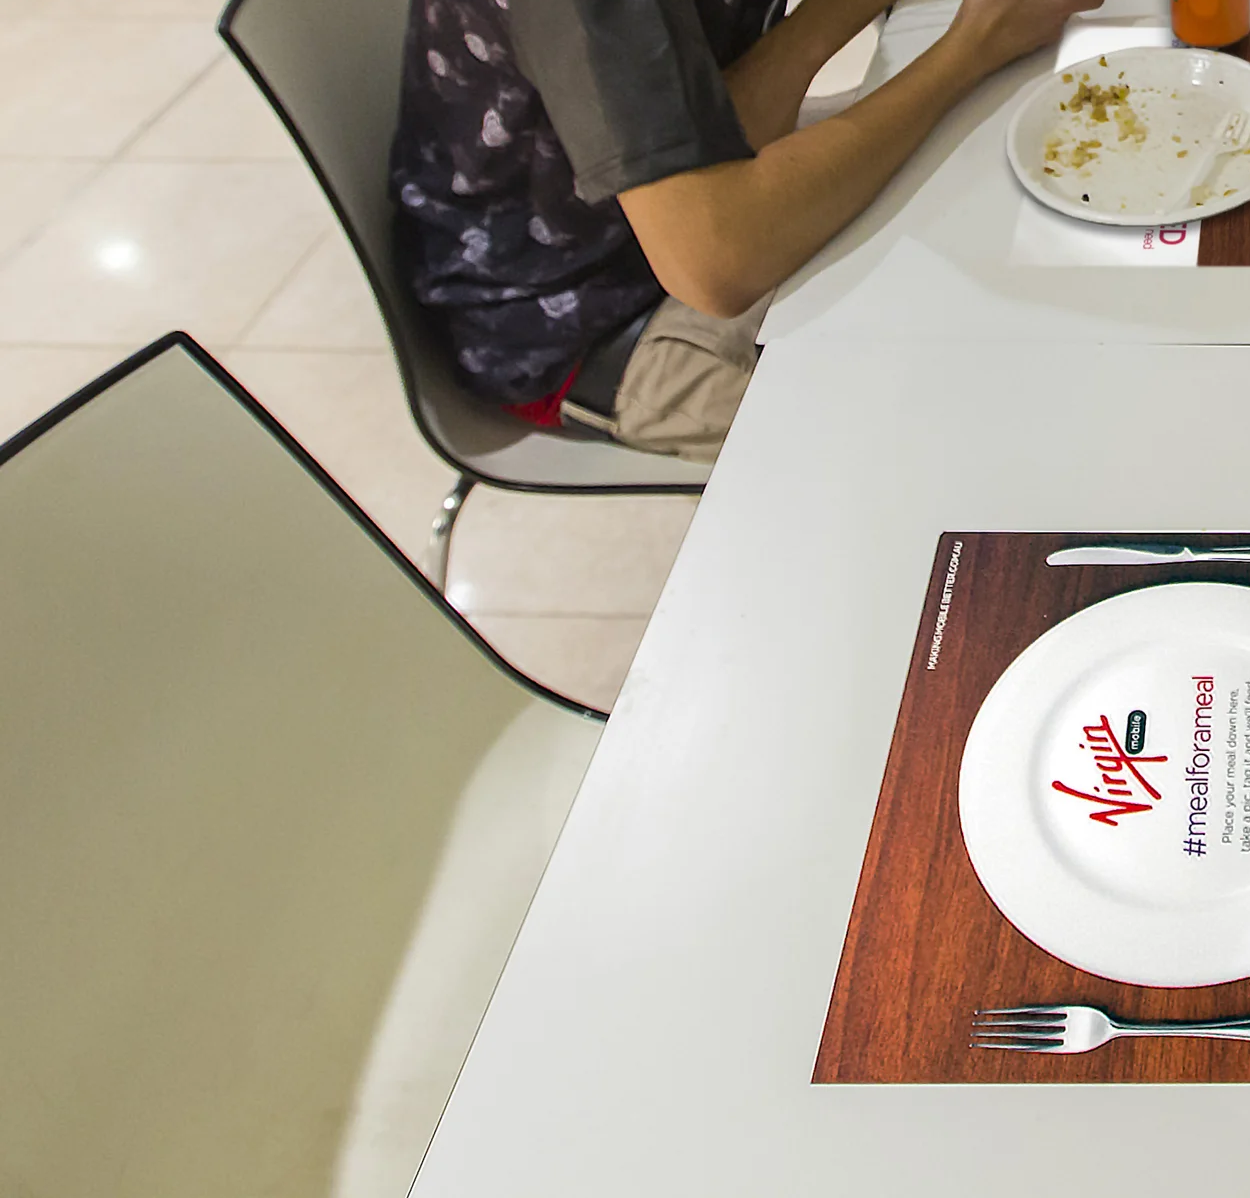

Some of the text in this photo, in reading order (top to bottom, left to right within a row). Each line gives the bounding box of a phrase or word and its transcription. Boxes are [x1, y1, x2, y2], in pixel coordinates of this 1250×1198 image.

[1143, 229, 1154, 249] need
[1130, 715, 1142, 749] mobile
[1226, 718, 1237, 747] down
[1052, 713, 1168, 826] Virgin
[1183, 676, 1213, 856] #mealforameal
[1225, 751, 1236, 778] meal
[1226, 782, 1236, 808] your
[1222, 812, 1234, 843] Place
[1241, 827, 1250, 852] take
